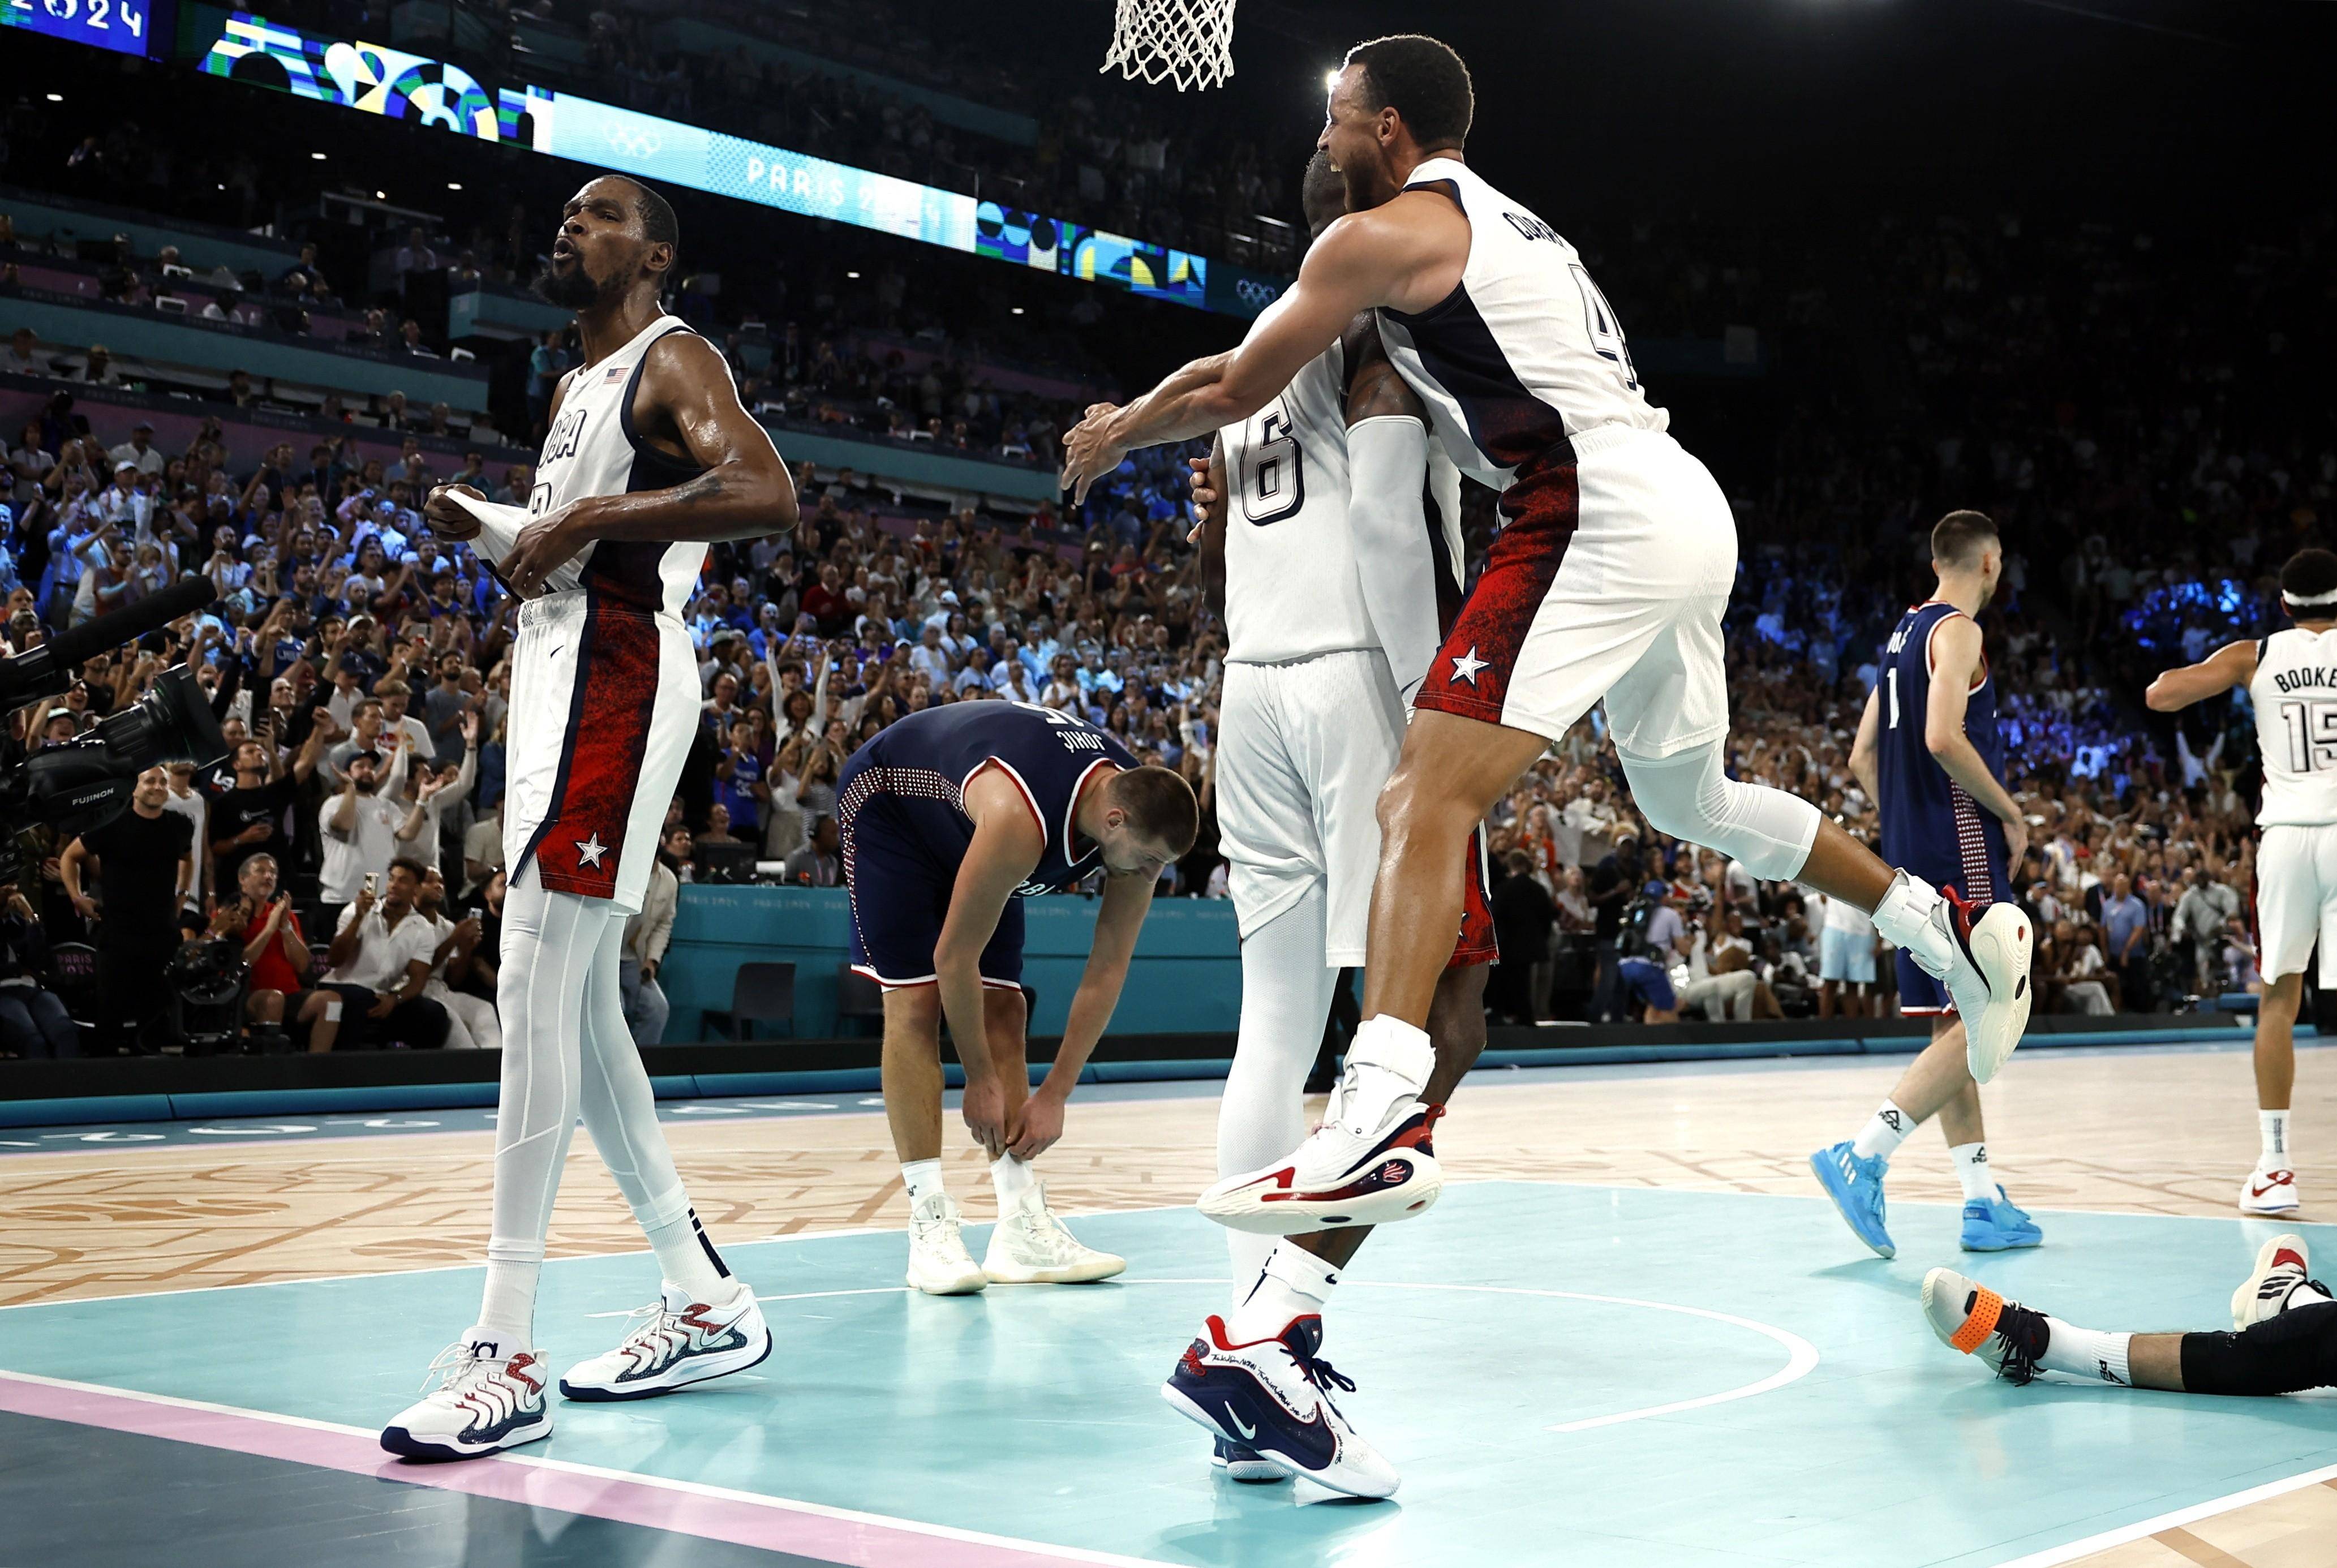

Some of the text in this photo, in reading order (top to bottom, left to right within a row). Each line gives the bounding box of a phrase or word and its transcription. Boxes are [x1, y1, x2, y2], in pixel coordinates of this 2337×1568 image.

[748, 158, 844, 206] PARIS
[1567, 263, 1637, 392] 4
[537, 409, 587, 464] USA
[1239, 394, 1305, 527] 6
[2281, 702, 2337, 772] 15
[72, 787, 115, 806] FUJINON
